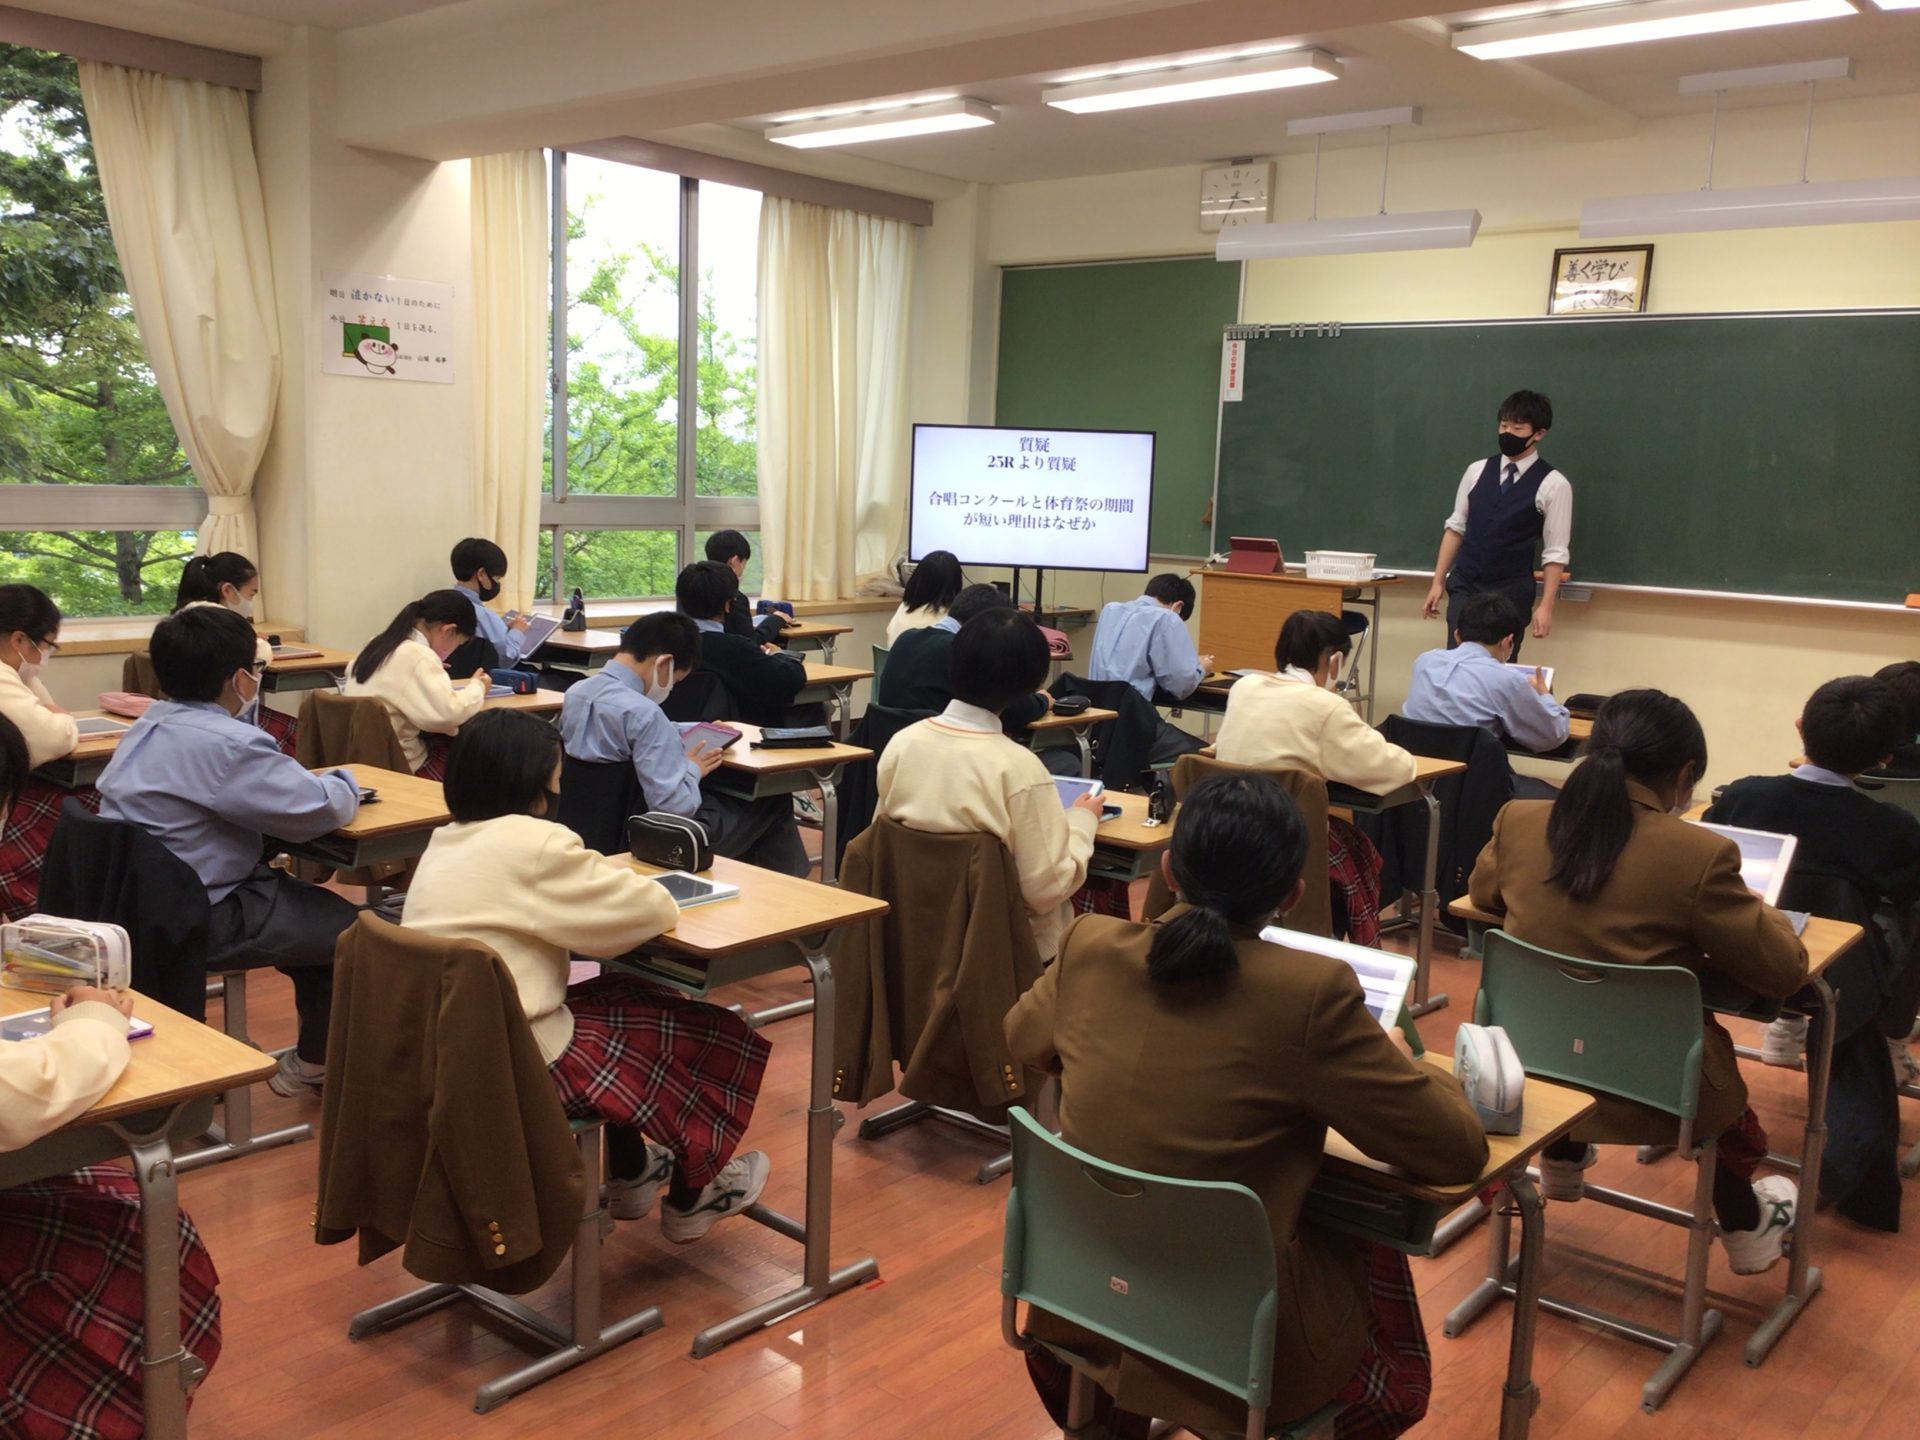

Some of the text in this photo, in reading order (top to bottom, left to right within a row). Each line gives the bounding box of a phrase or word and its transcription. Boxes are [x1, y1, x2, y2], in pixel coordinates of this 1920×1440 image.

[1019, 437, 1050, 453] 質疑
[928, 490, 1134, 514] 合唱コンクールと体育祭の期間
[963, 512, 1097, 531] が短い理由はなぜか
